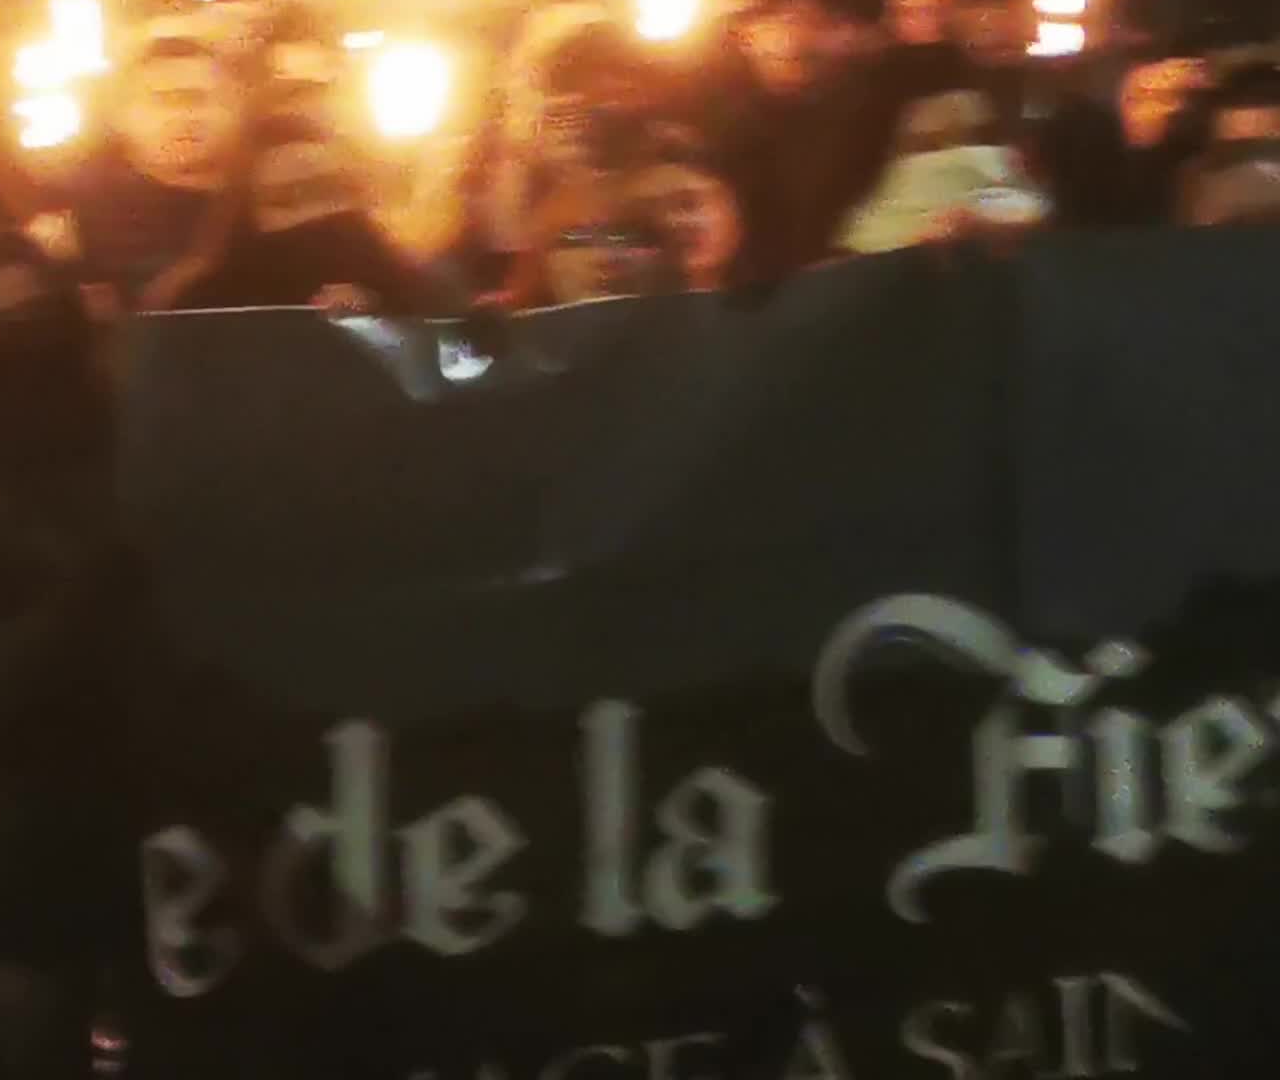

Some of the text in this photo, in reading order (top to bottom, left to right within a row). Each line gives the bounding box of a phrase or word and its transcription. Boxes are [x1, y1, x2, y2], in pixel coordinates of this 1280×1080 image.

[265, 718, 527, 972] de
[578, 697, 780, 937] la
[900, 970, 1194, 1080] SAIN
